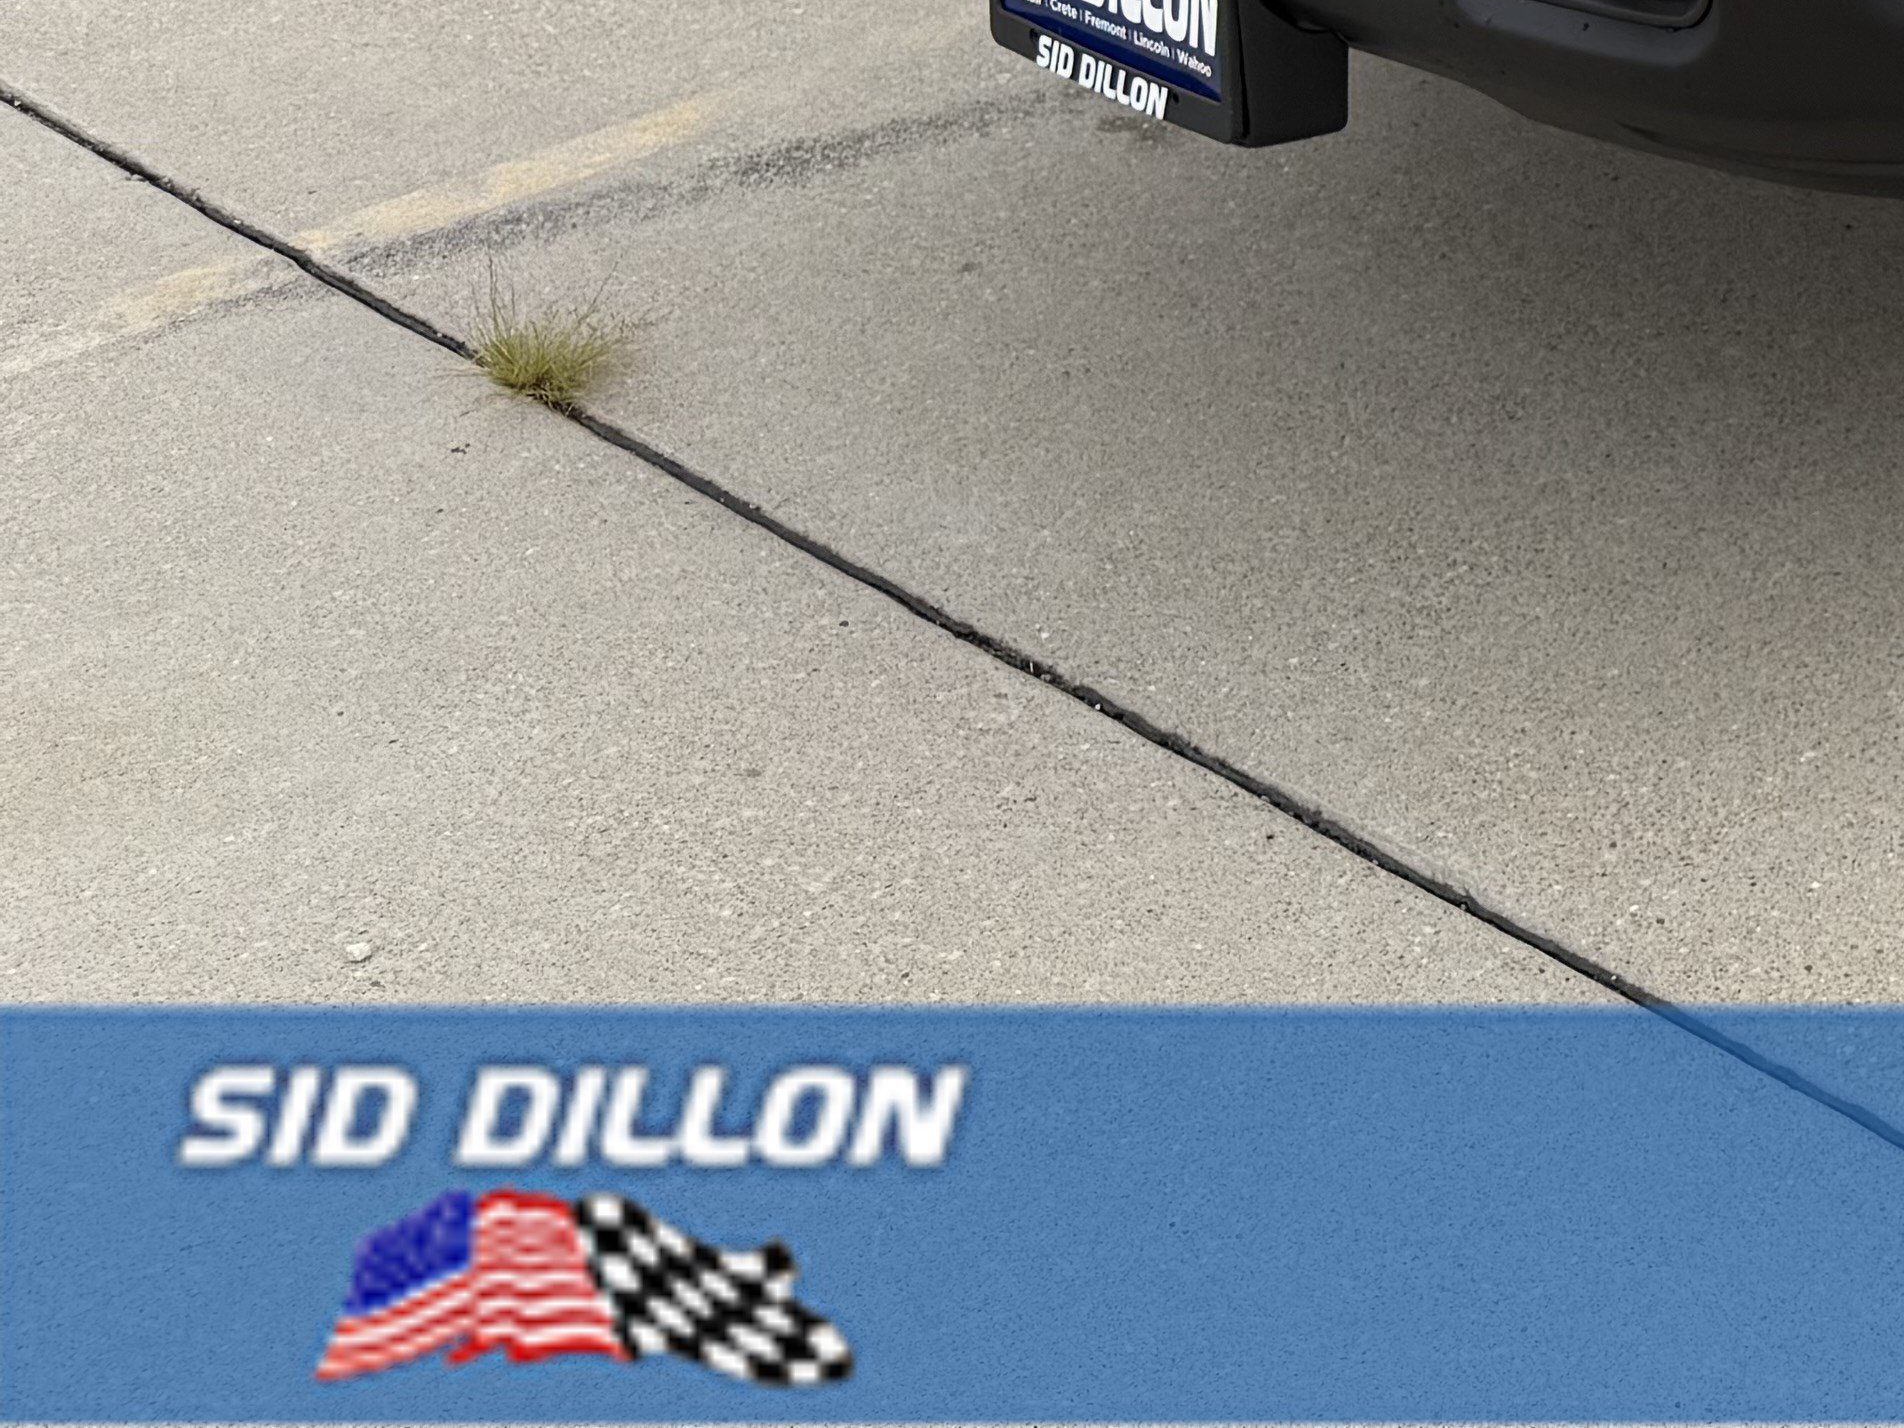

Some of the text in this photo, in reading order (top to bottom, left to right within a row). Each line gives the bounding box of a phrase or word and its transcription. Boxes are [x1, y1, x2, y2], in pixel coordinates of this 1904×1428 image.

[1084, 10, 1128, 40] Fremont
[1133, 30, 1171, 58] Lincoln
[1035, 34, 1169, 121] SID DILLON
